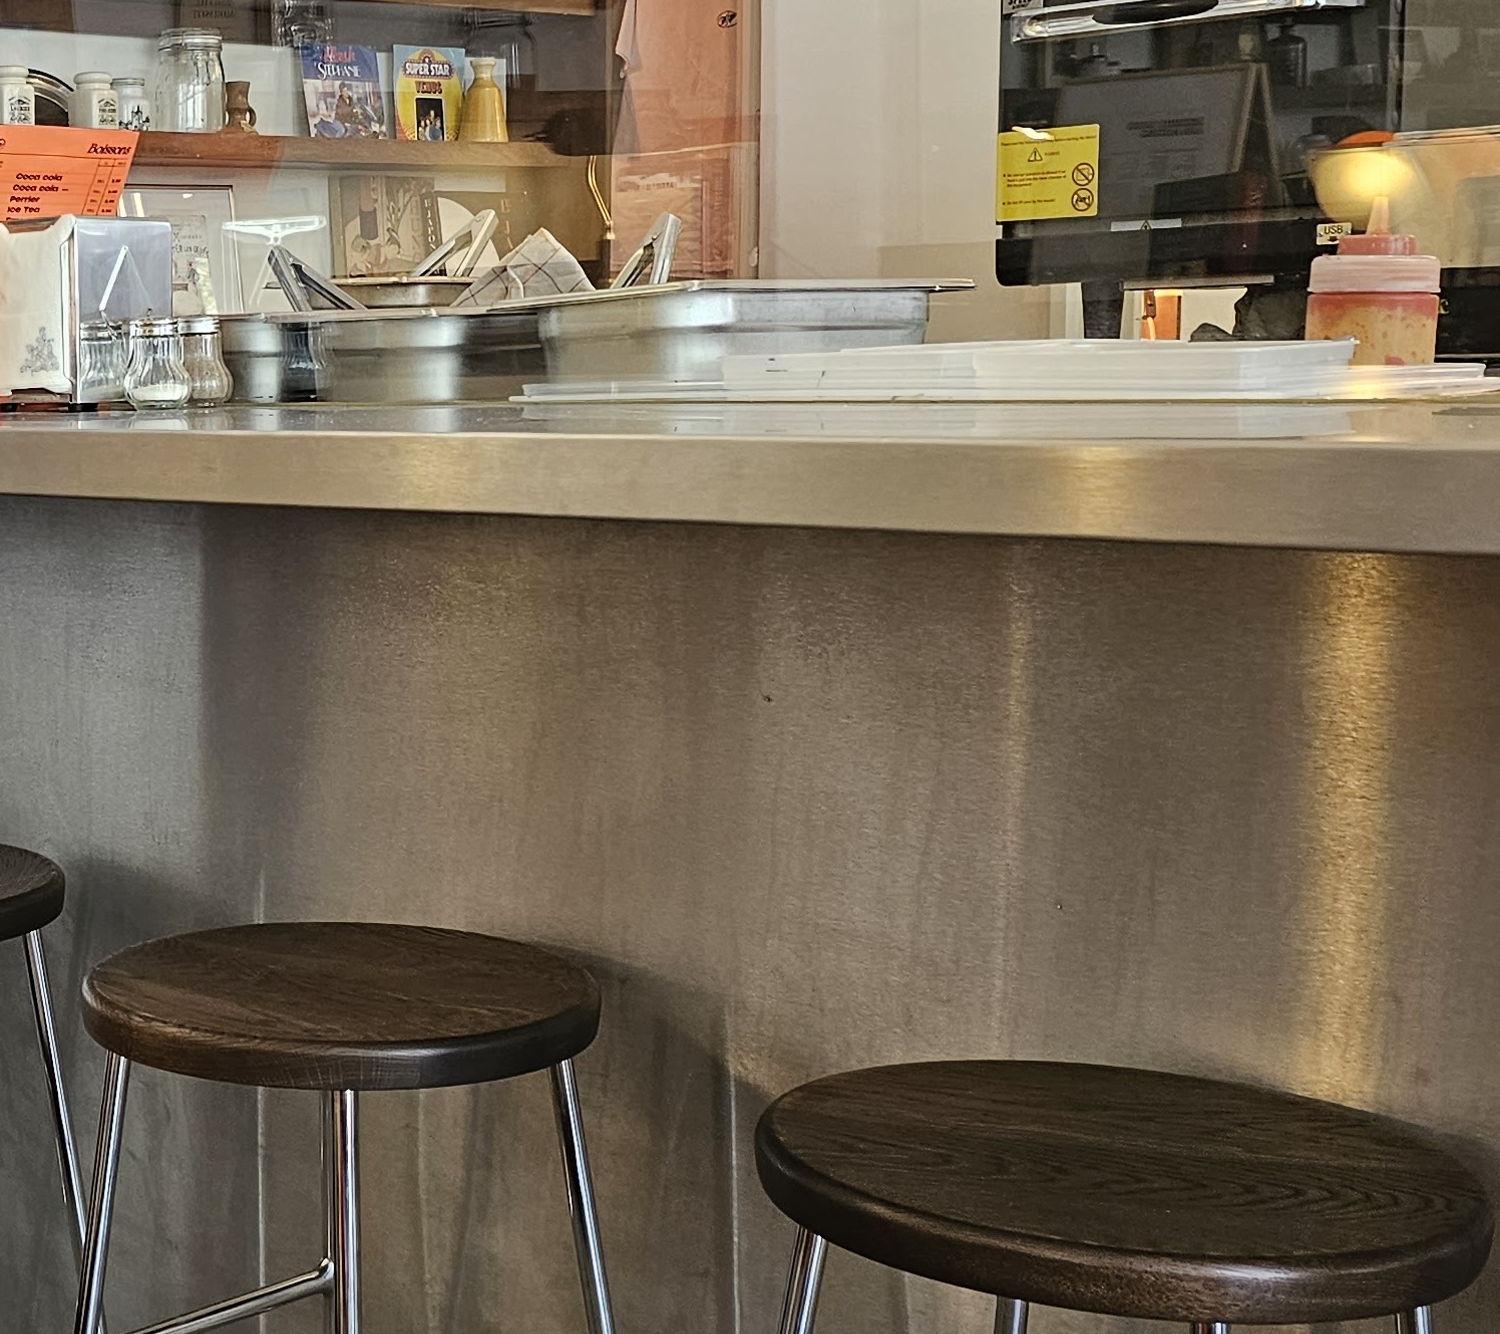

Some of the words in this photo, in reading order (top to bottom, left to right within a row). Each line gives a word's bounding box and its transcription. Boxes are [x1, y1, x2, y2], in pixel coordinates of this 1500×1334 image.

[406, 63, 429, 75] SUPER
[430, 64, 450, 76] STAR
[415, 81, 442, 94] VENUS
[87, 143, 131, 155] Boissons
[16, 173, 40, 181] Coca
[42, 173, 63, 181] cola
[12, 184, 37, 192] Coca
[1324, 225, 1343, 234] USB
